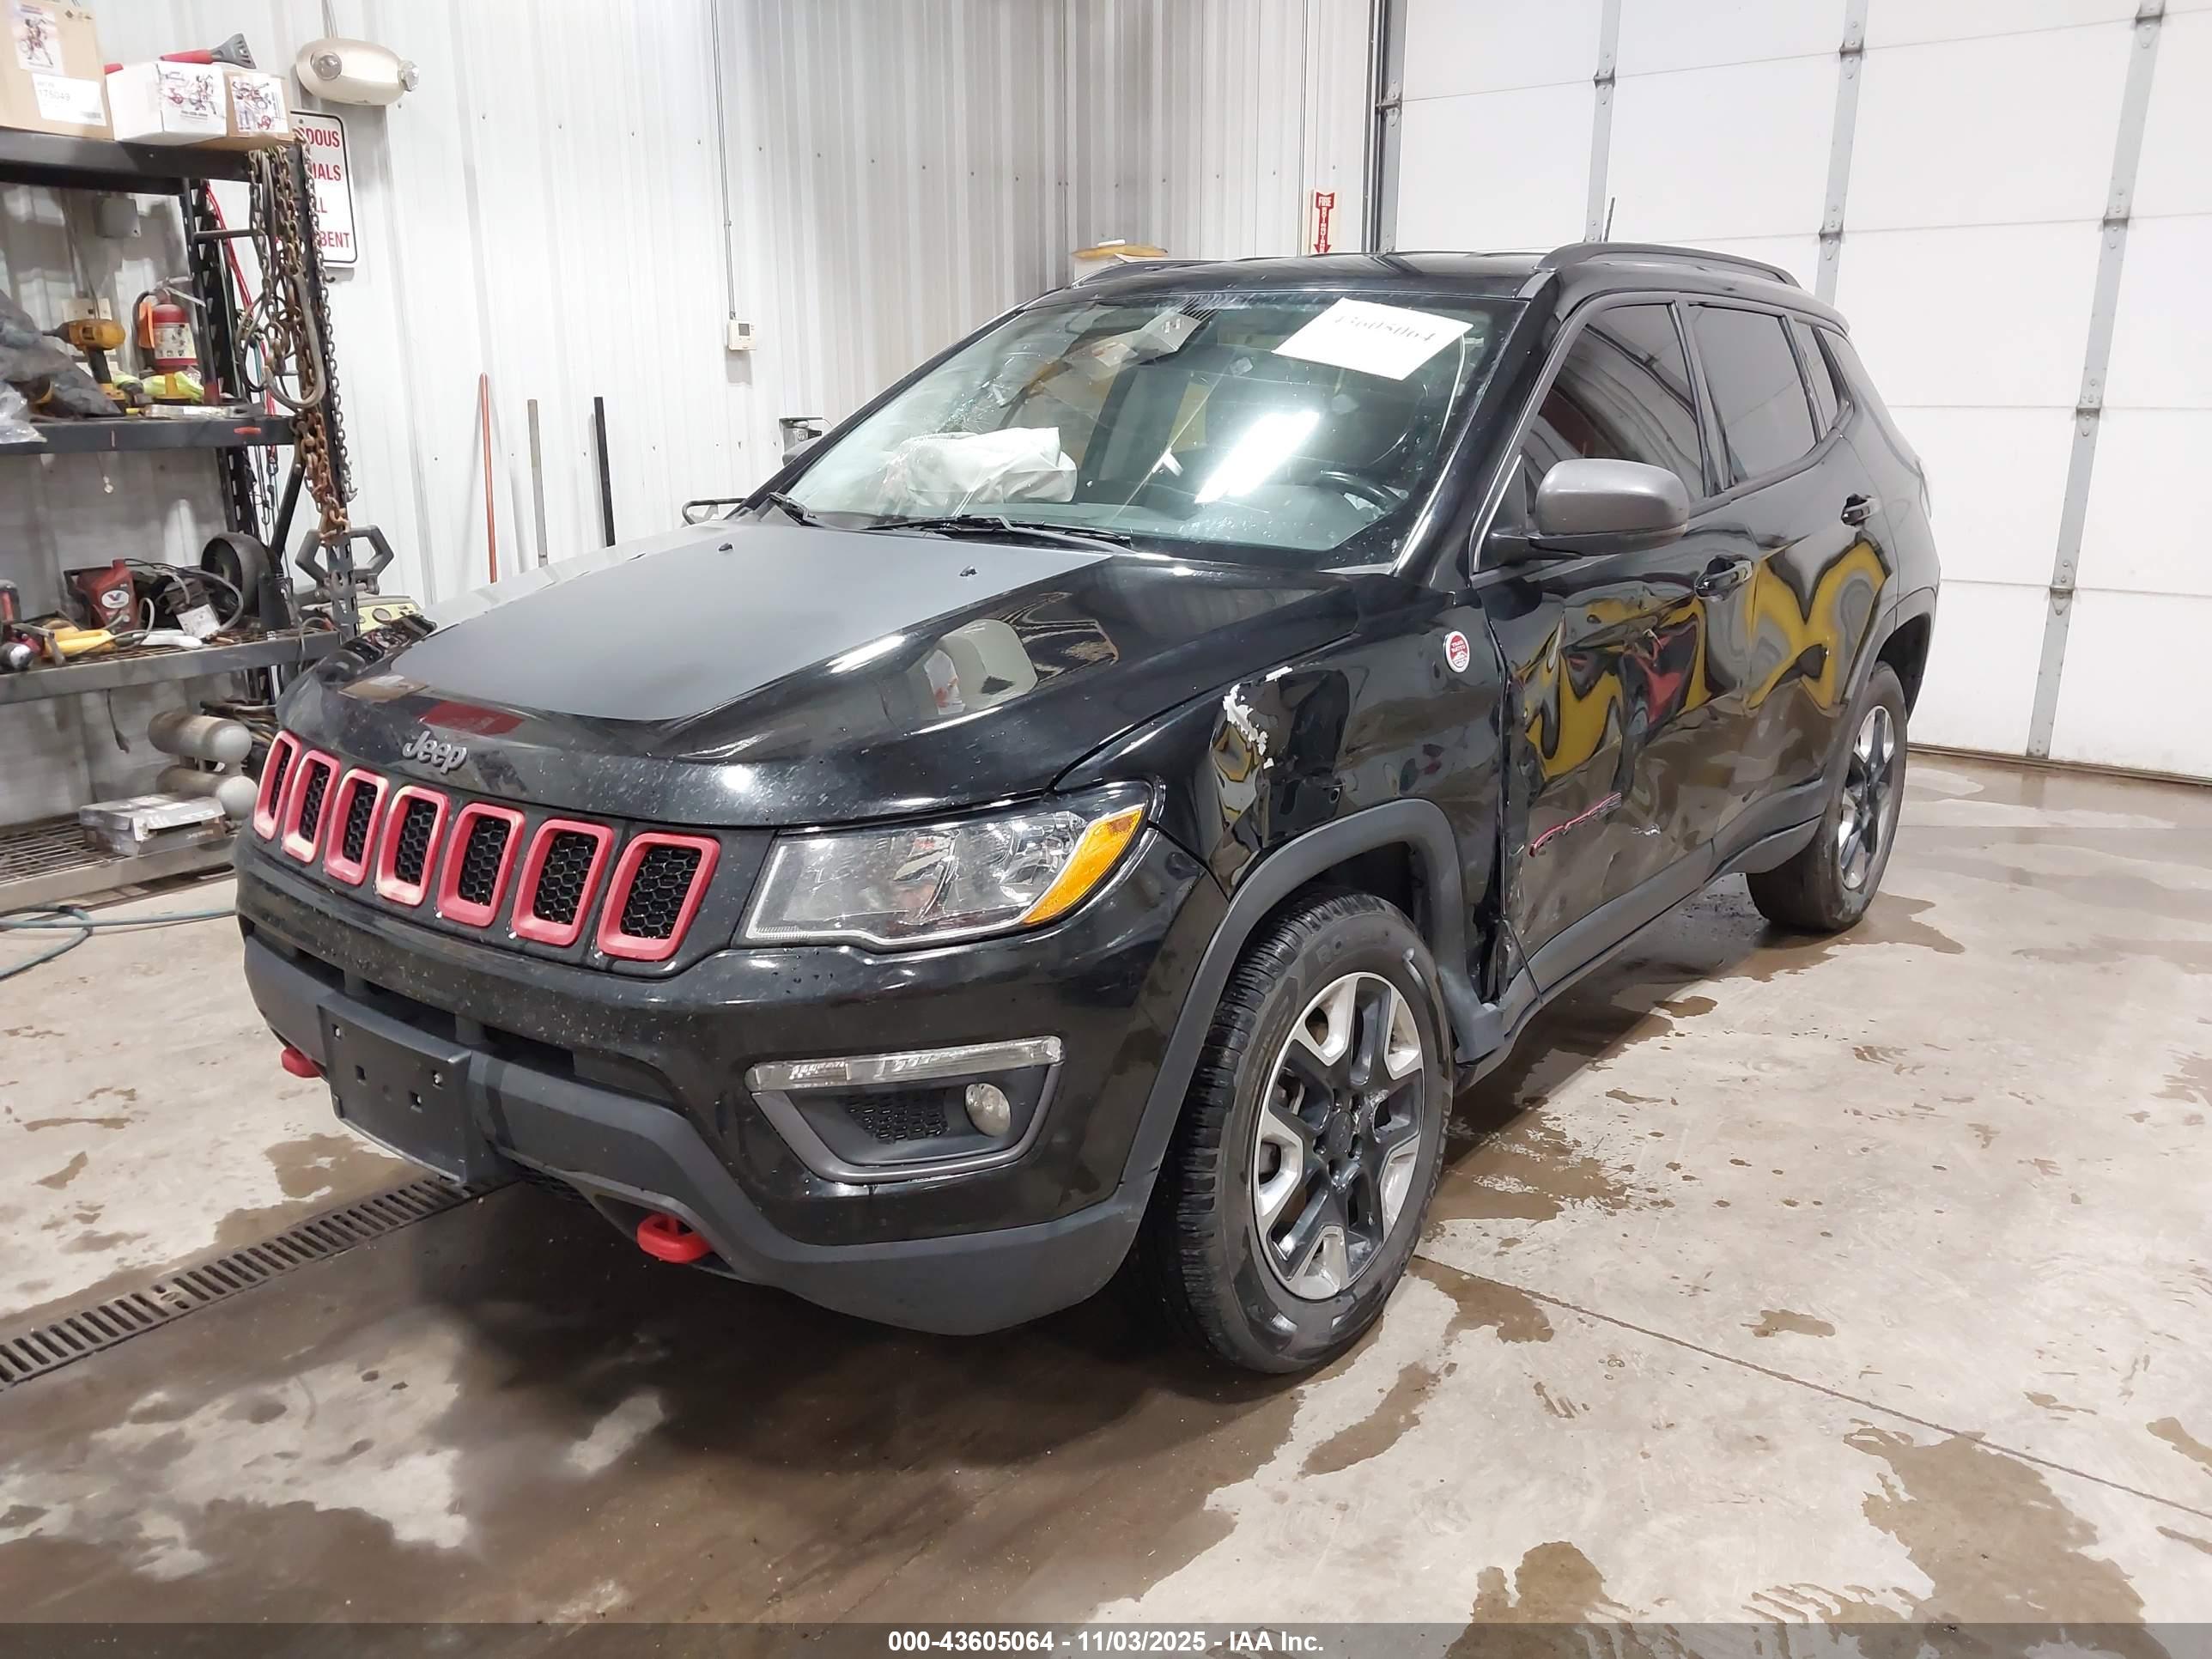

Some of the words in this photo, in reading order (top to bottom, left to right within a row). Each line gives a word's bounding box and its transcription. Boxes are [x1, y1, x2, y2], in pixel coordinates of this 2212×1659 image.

[302, 128, 340, 148] DOUS
[312, 163, 342, 181] IALS
[319, 230, 350, 249] BENT
[402, 730, 468, 775] Jeep
